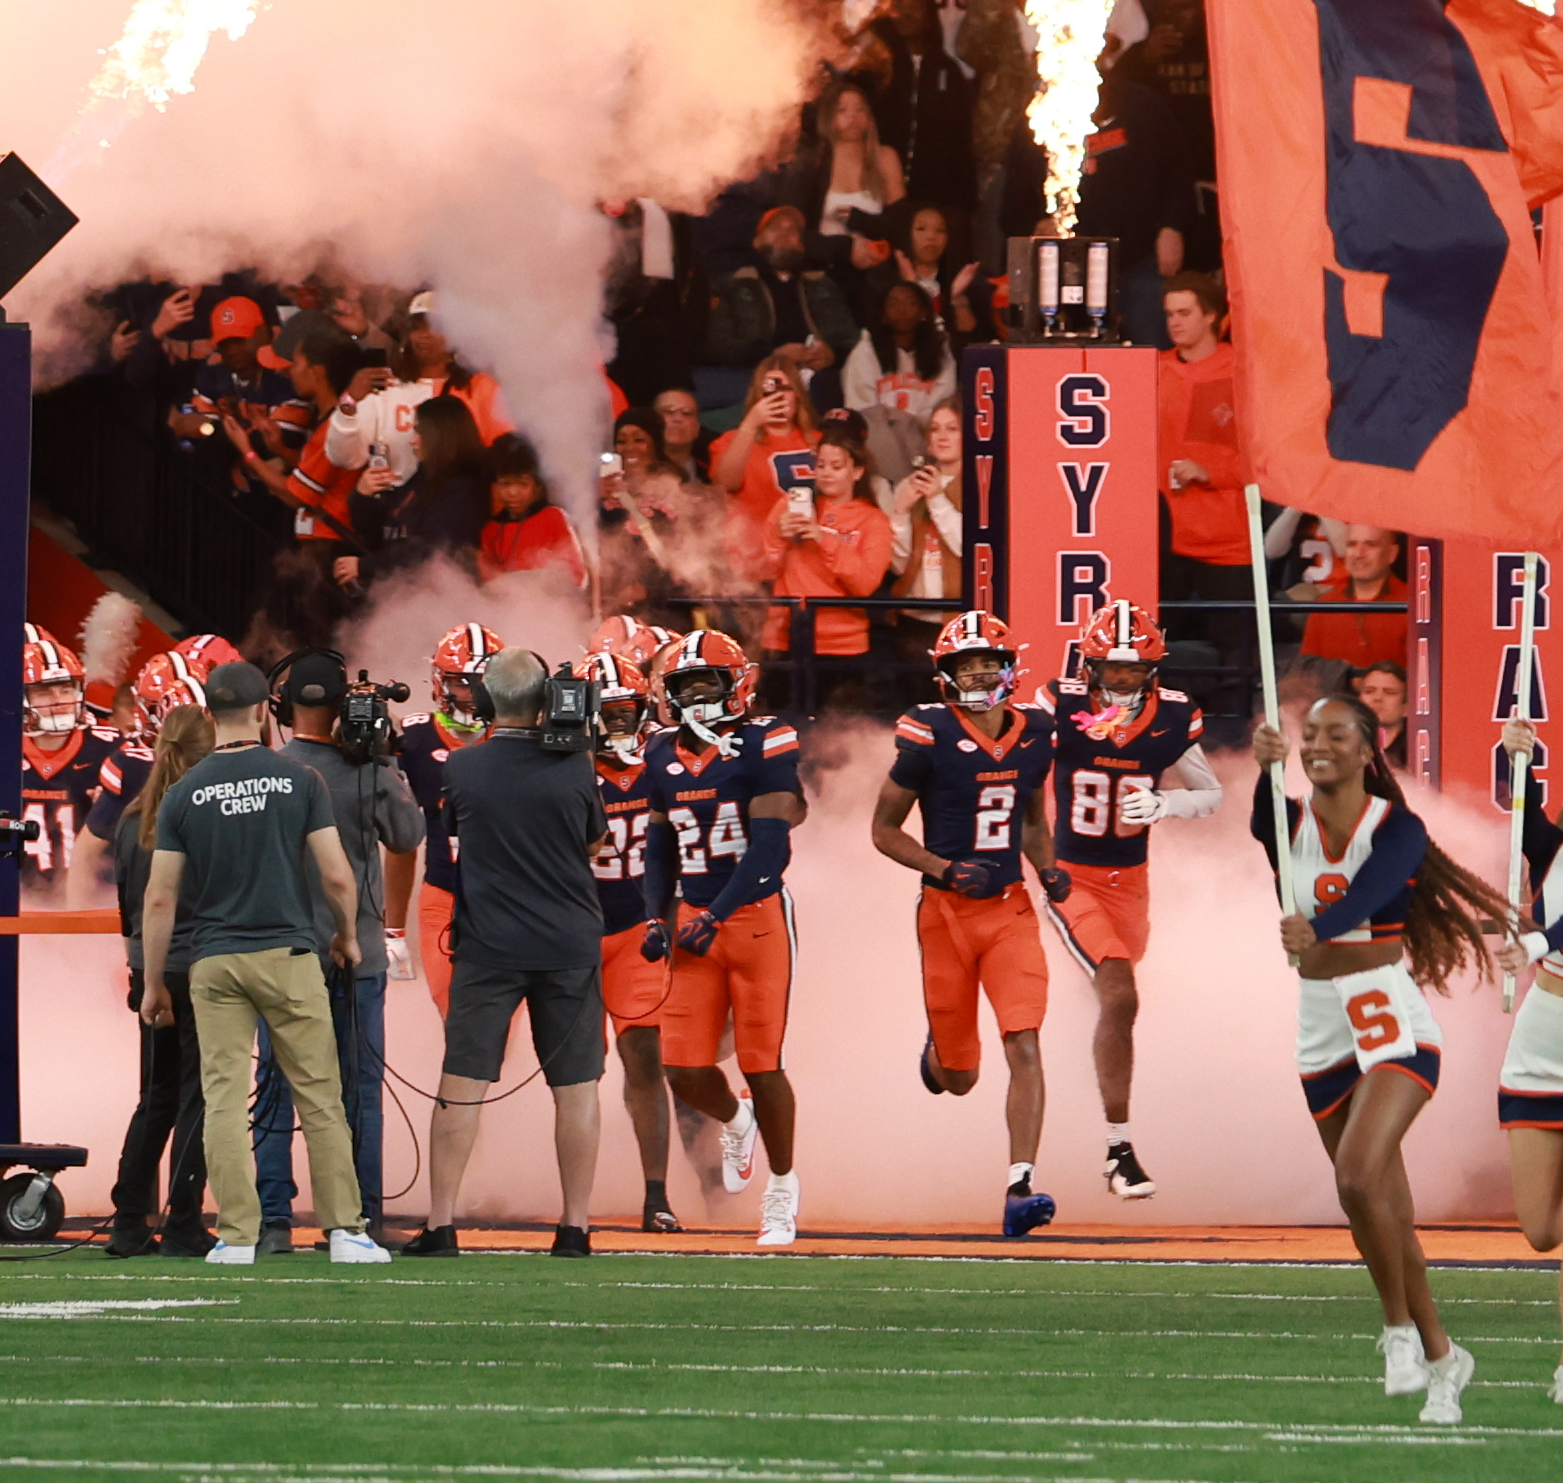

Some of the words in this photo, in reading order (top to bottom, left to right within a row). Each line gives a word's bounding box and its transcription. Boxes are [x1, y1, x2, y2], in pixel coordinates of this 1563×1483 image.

[192, 776, 294, 808] OPERATIONS
[219, 794, 268, 818] CREW
[674, 788, 719, 802] ORANGE
[974, 784, 1016, 851] 2
[22, 802, 77, 871] 41
[590, 813, 650, 880] 22
[668, 801, 749, 876] 24
[1345, 988, 1404, 1053] S
